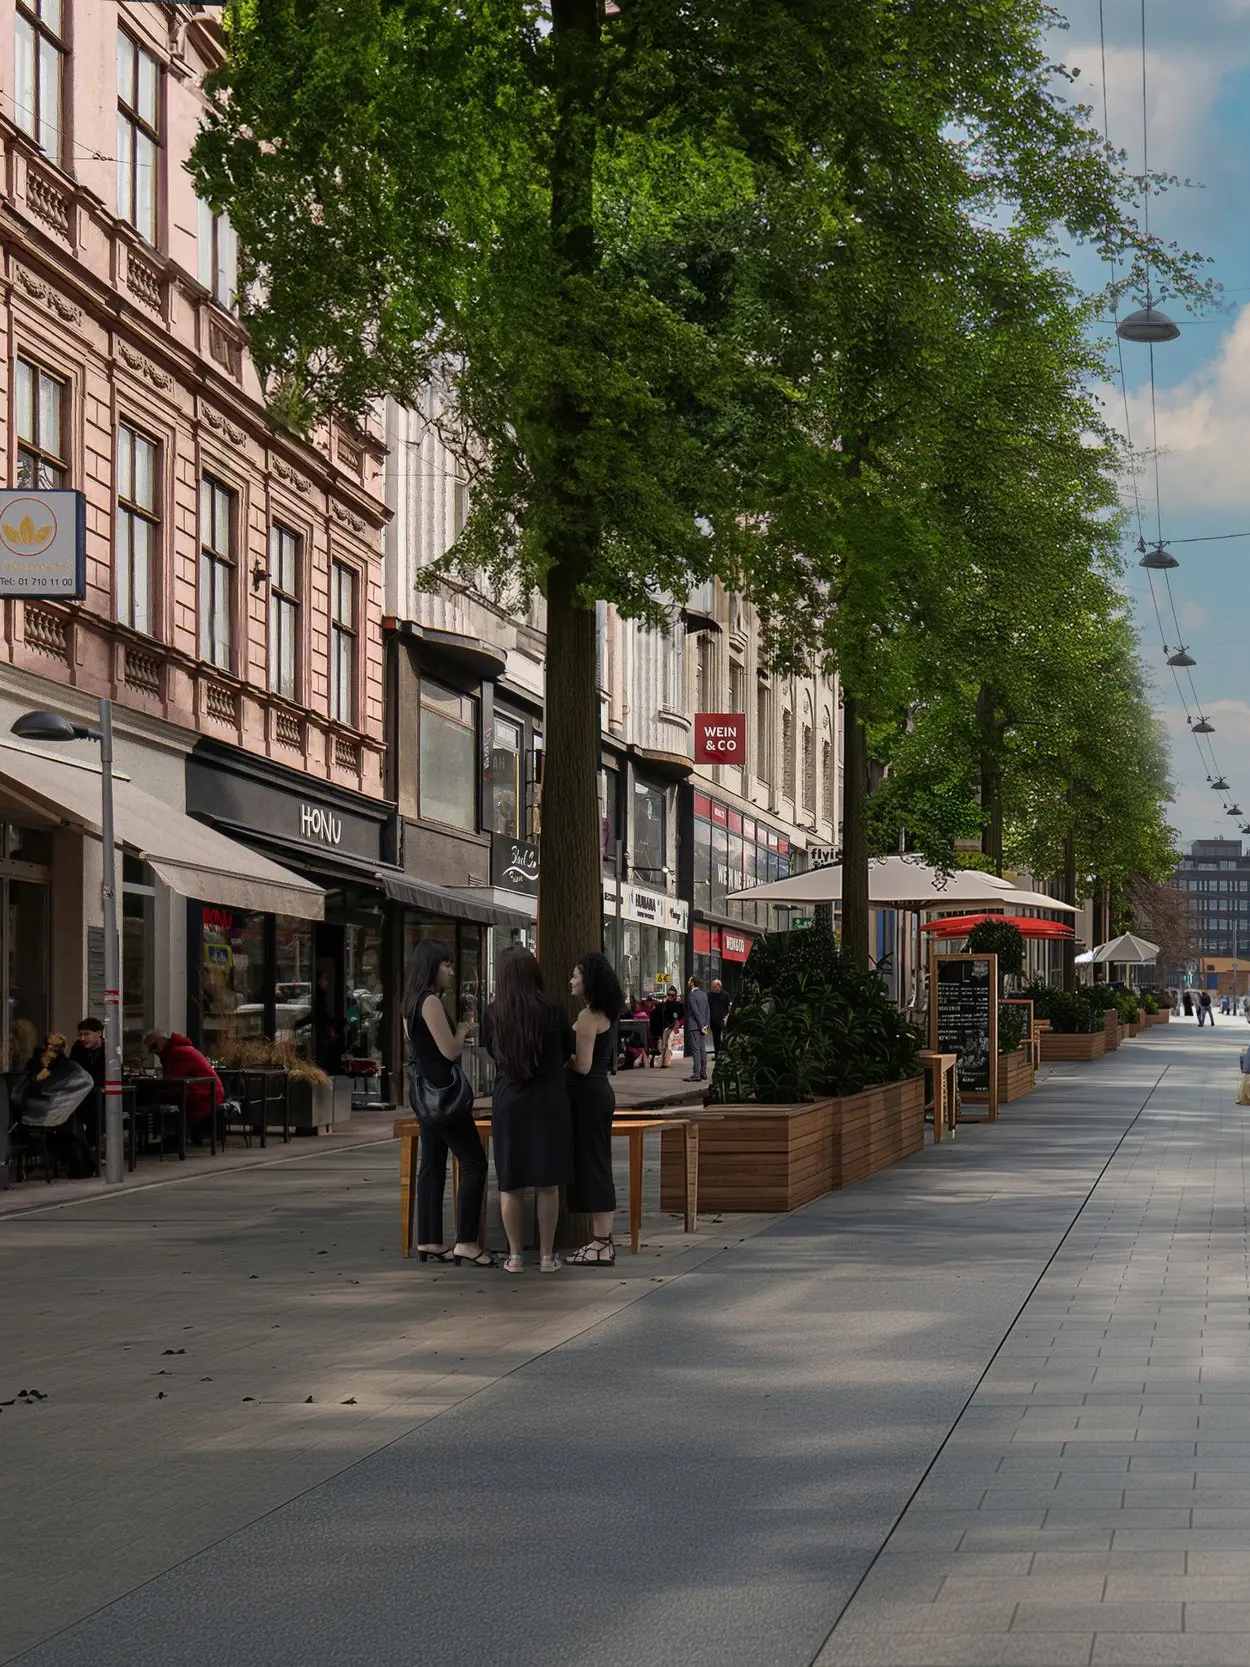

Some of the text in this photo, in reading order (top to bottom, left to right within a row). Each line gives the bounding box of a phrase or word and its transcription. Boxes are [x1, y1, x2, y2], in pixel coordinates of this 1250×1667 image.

[18, 577, 28, 586] 01
[31, 577, 47, 586] 710
[51, 578, 59, 586] 11
[62, 578, 73, 587] 00
[704, 726, 737, 738] WEIN
[706, 740, 737, 751] & CO
[302, 803, 342, 844] HONU
